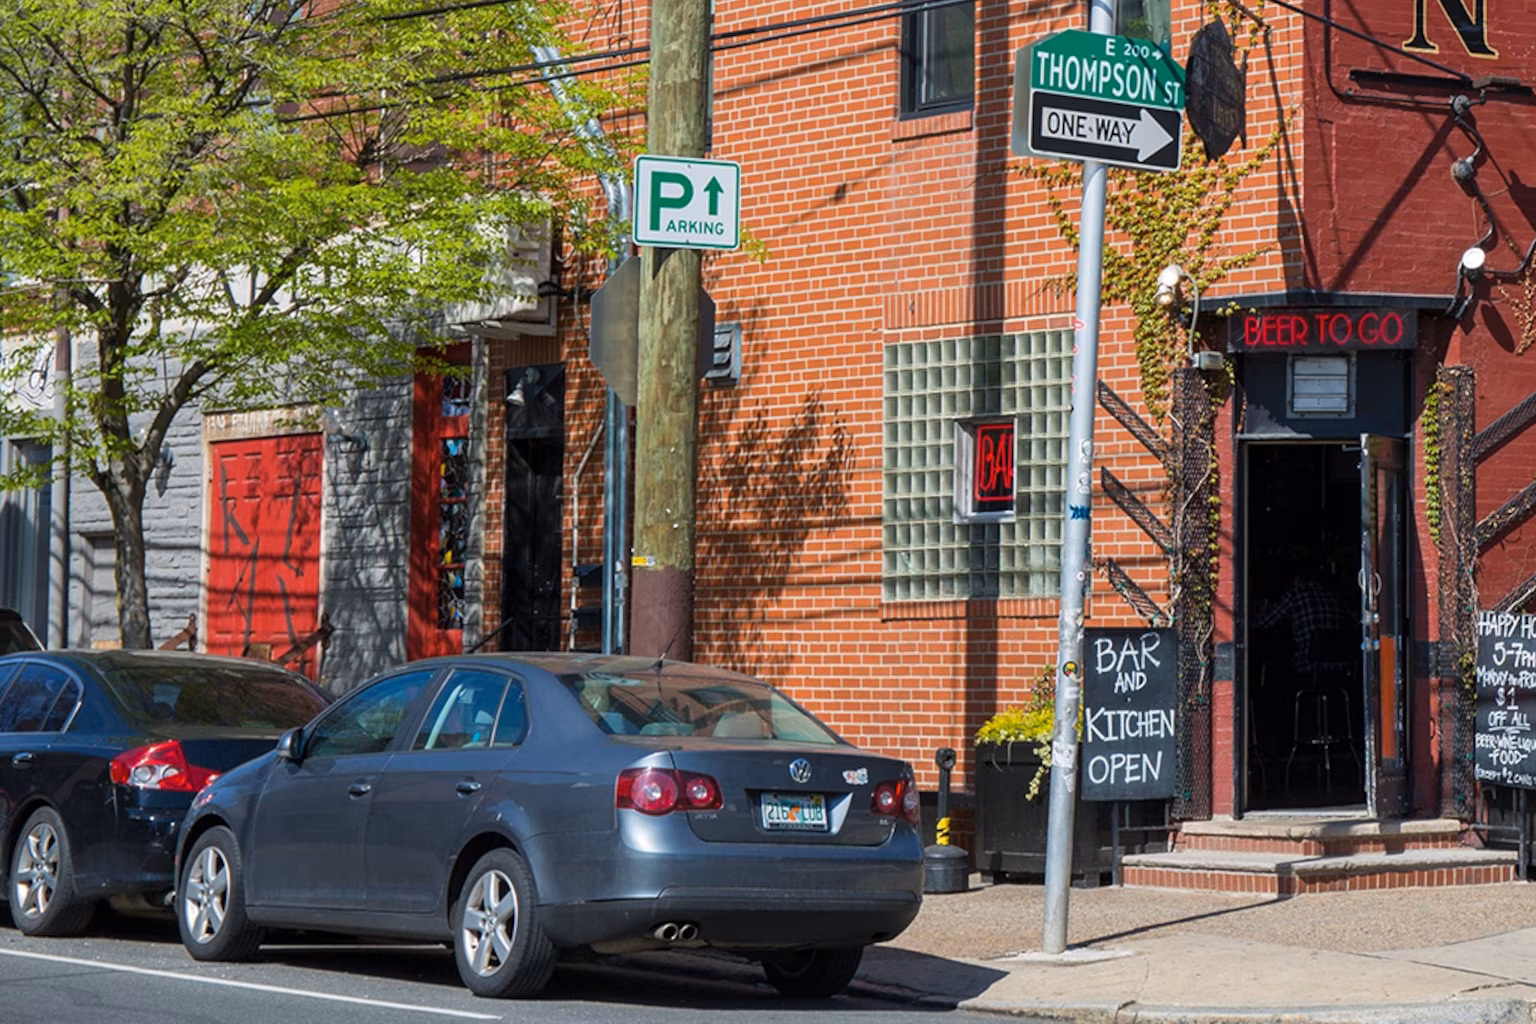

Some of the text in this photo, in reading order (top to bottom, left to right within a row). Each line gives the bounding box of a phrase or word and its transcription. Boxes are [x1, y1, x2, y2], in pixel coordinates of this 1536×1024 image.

[1105, 38, 1149, 59] E 200
[1037, 51, 1180, 105] THOMPSON ST
[1047, 111, 1136, 144] ONE WAY
[1244, 312, 1403, 346] BEER TO GO
[1478, 611, 1520, 637] HAPPY
[1094, 632, 1160, 674] BAR
[1114, 671, 1147, 693] AND
[1476, 665, 1508, 687] MONDAY
[1085, 707, 1175, 743] KITCHEN
[1488, 711, 1531, 726] OFF ALL
[1088, 751, 1162, 784] OPEN
